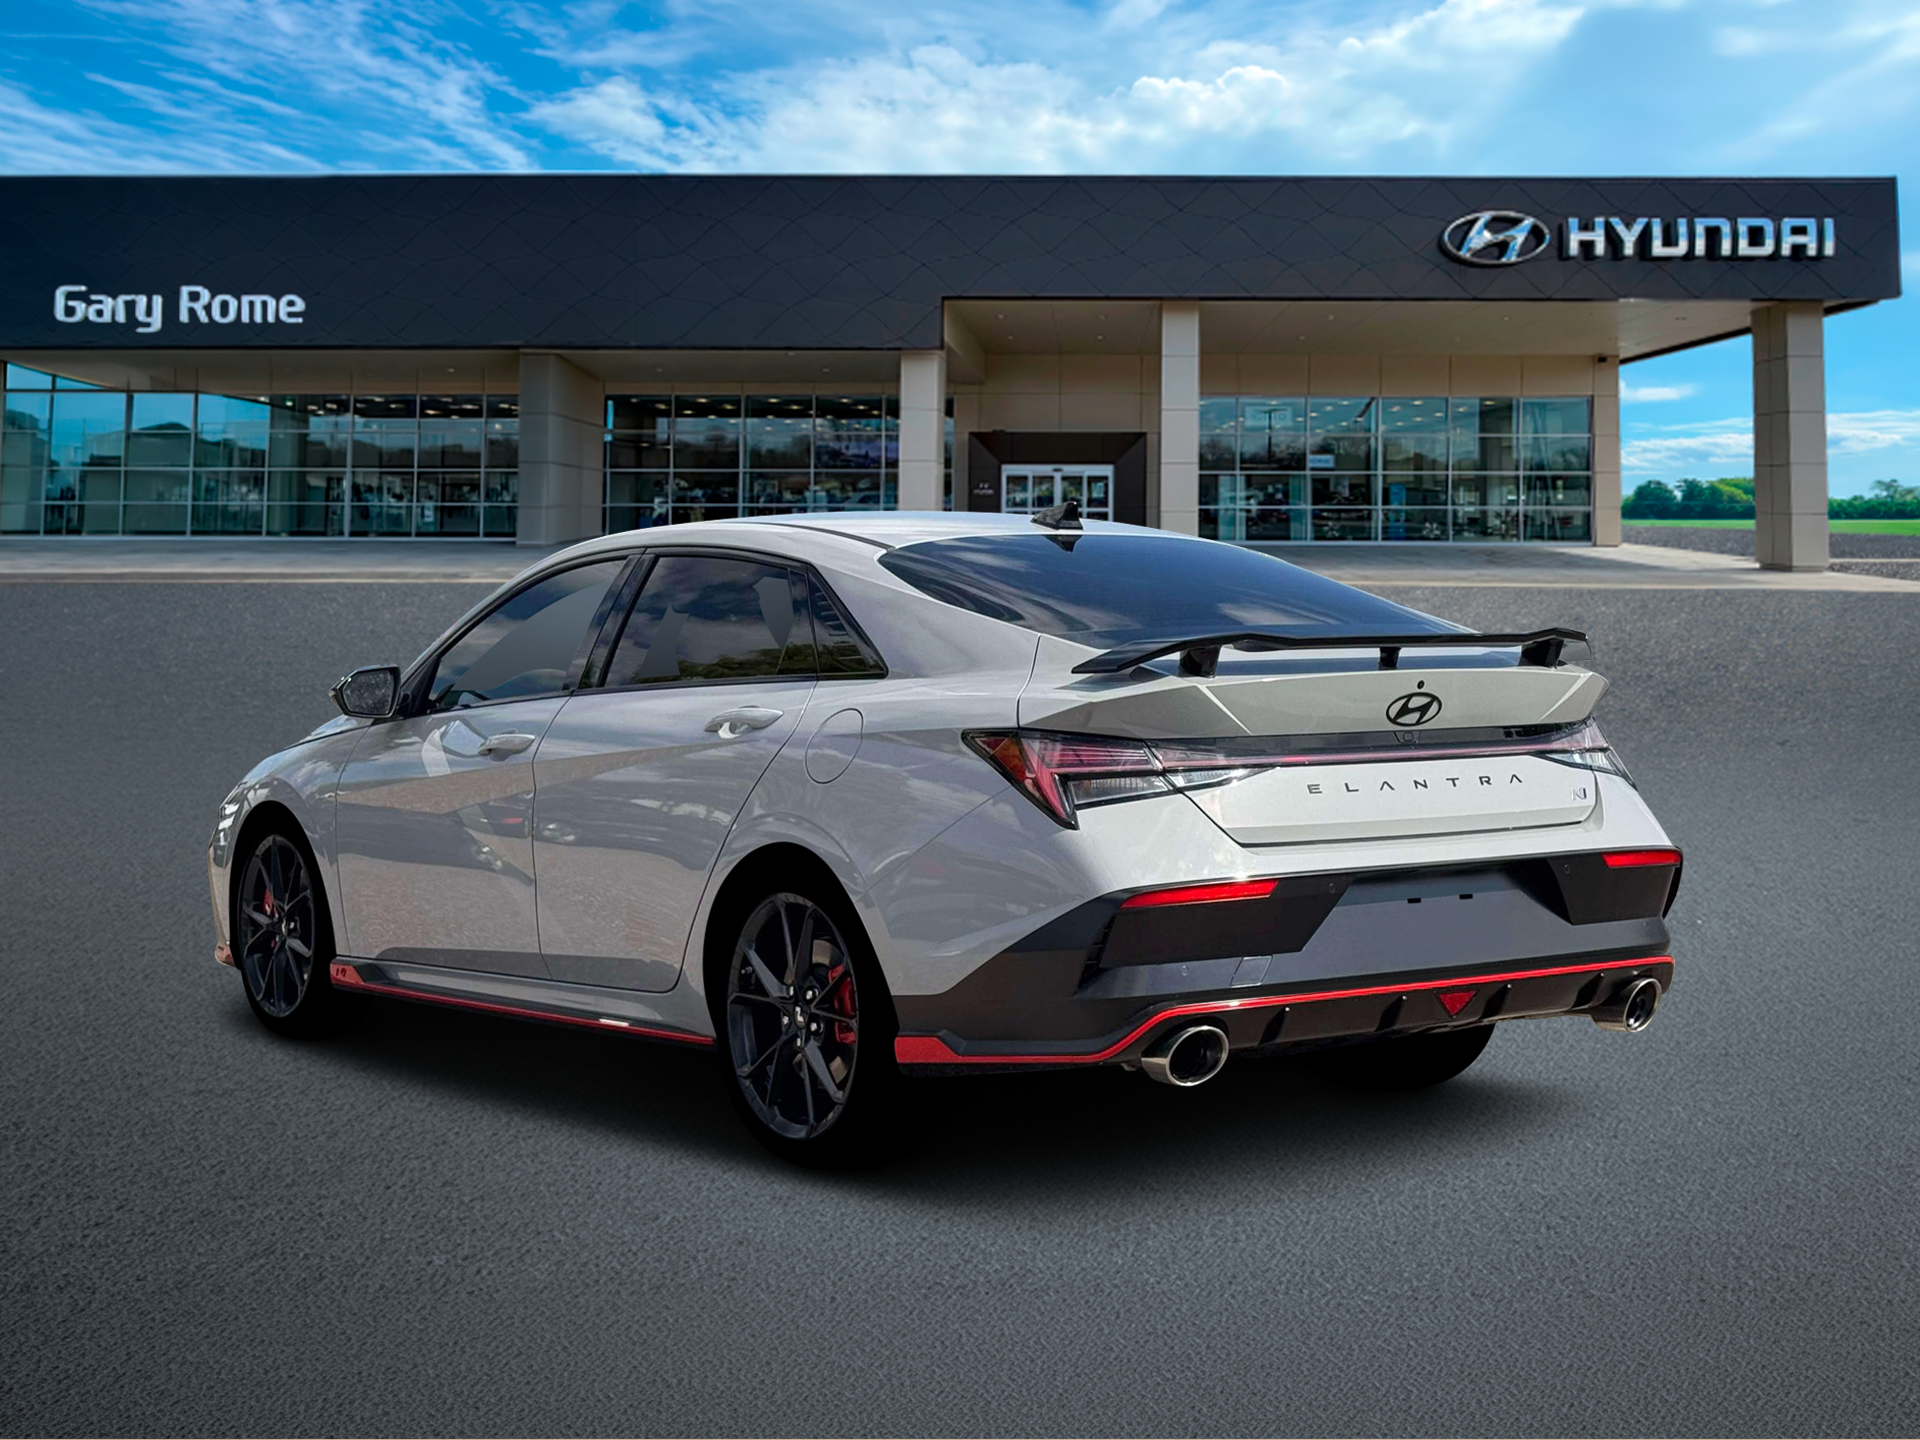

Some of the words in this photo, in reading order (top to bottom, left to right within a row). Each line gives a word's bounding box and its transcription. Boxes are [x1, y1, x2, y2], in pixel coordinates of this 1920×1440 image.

[1566, 216, 1836, 258] HYUNDAI
[54, 284, 164, 334] Gary
[178, 284, 306, 324] Rome
[1306, 773, 1524, 795] ELANTRA
